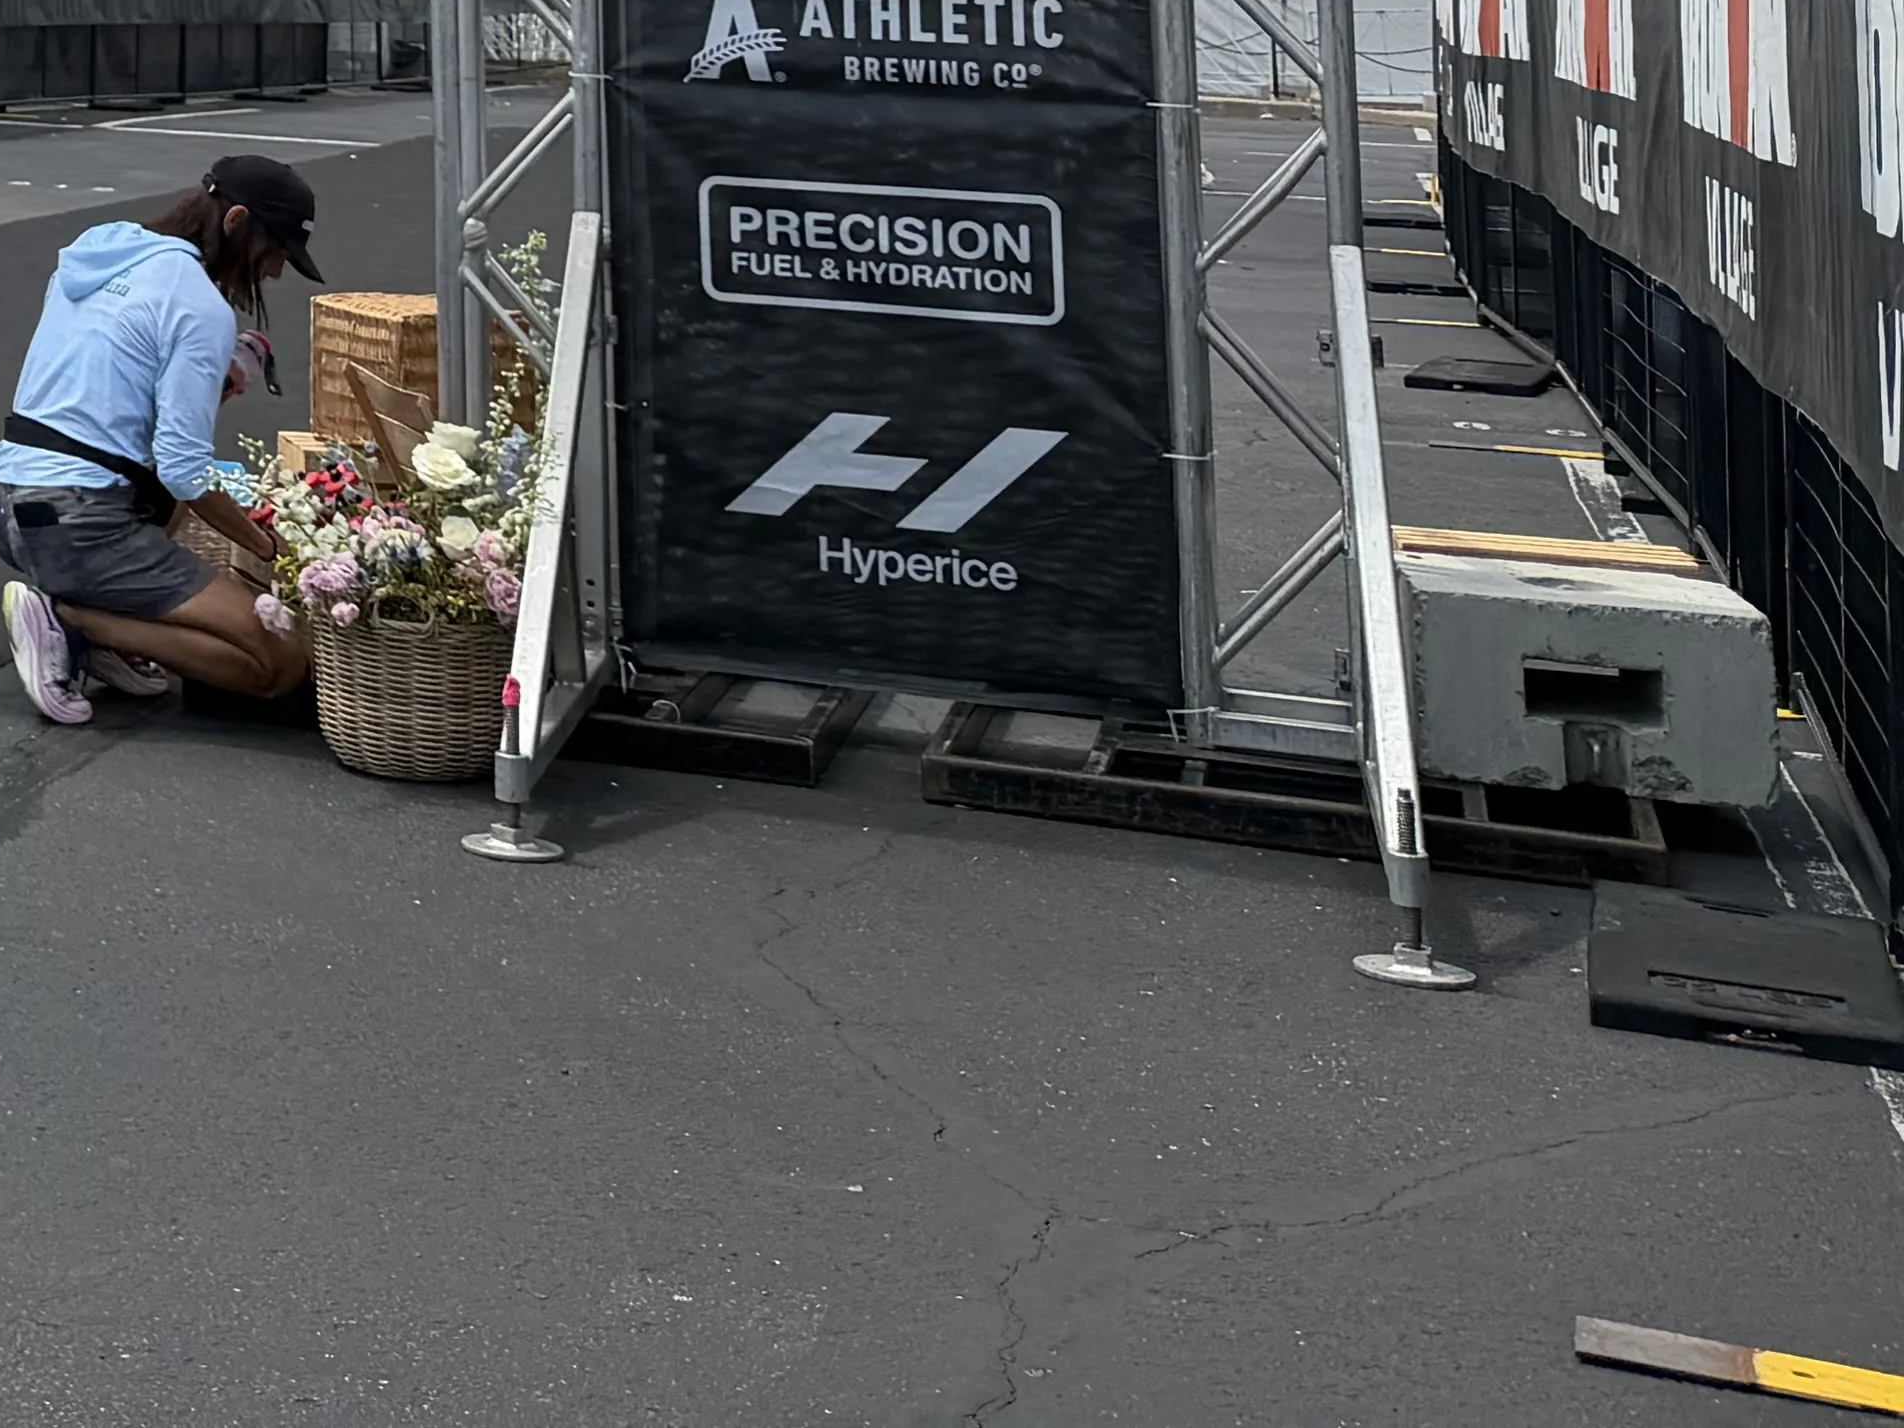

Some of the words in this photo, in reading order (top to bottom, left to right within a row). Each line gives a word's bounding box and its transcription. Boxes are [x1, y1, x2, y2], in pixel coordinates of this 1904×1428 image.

[844, 55, 980, 87] BREWING
[729, 206, 1031, 264] PRECISION
[731, 252, 812, 281] FUEL
[819, 258, 841, 282] &
[846, 259, 1033, 296] HYDRATION
[819, 536, 1019, 592] Hyperice
